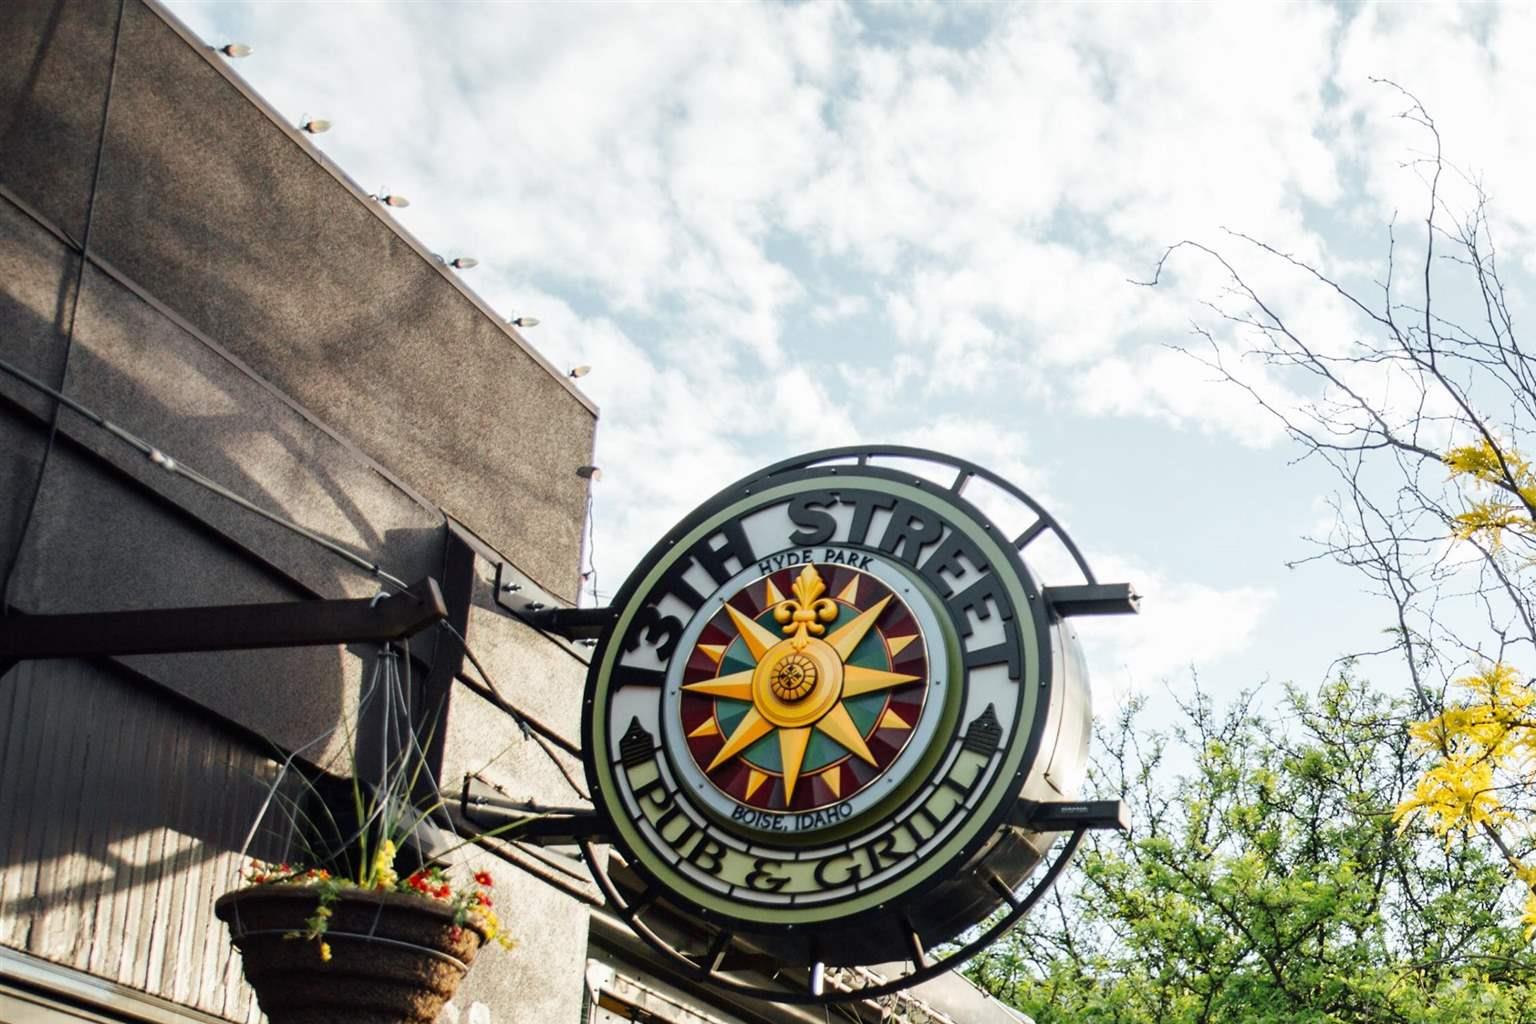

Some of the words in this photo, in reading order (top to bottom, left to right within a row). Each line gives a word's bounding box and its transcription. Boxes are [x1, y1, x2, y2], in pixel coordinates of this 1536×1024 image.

[612, 519, 758, 693] 13TH
[787, 489, 1020, 681] STREET
[758, 549, 813, 576] HYDE
[825, 549, 874, 572] PARK
[634, 778, 728, 876] PUB
[745, 858, 791, 893] &
[813, 763, 986, 890] GRILL
[731, 805, 788, 832] BOISE,
[794, 801, 853, 831] IDAHO
